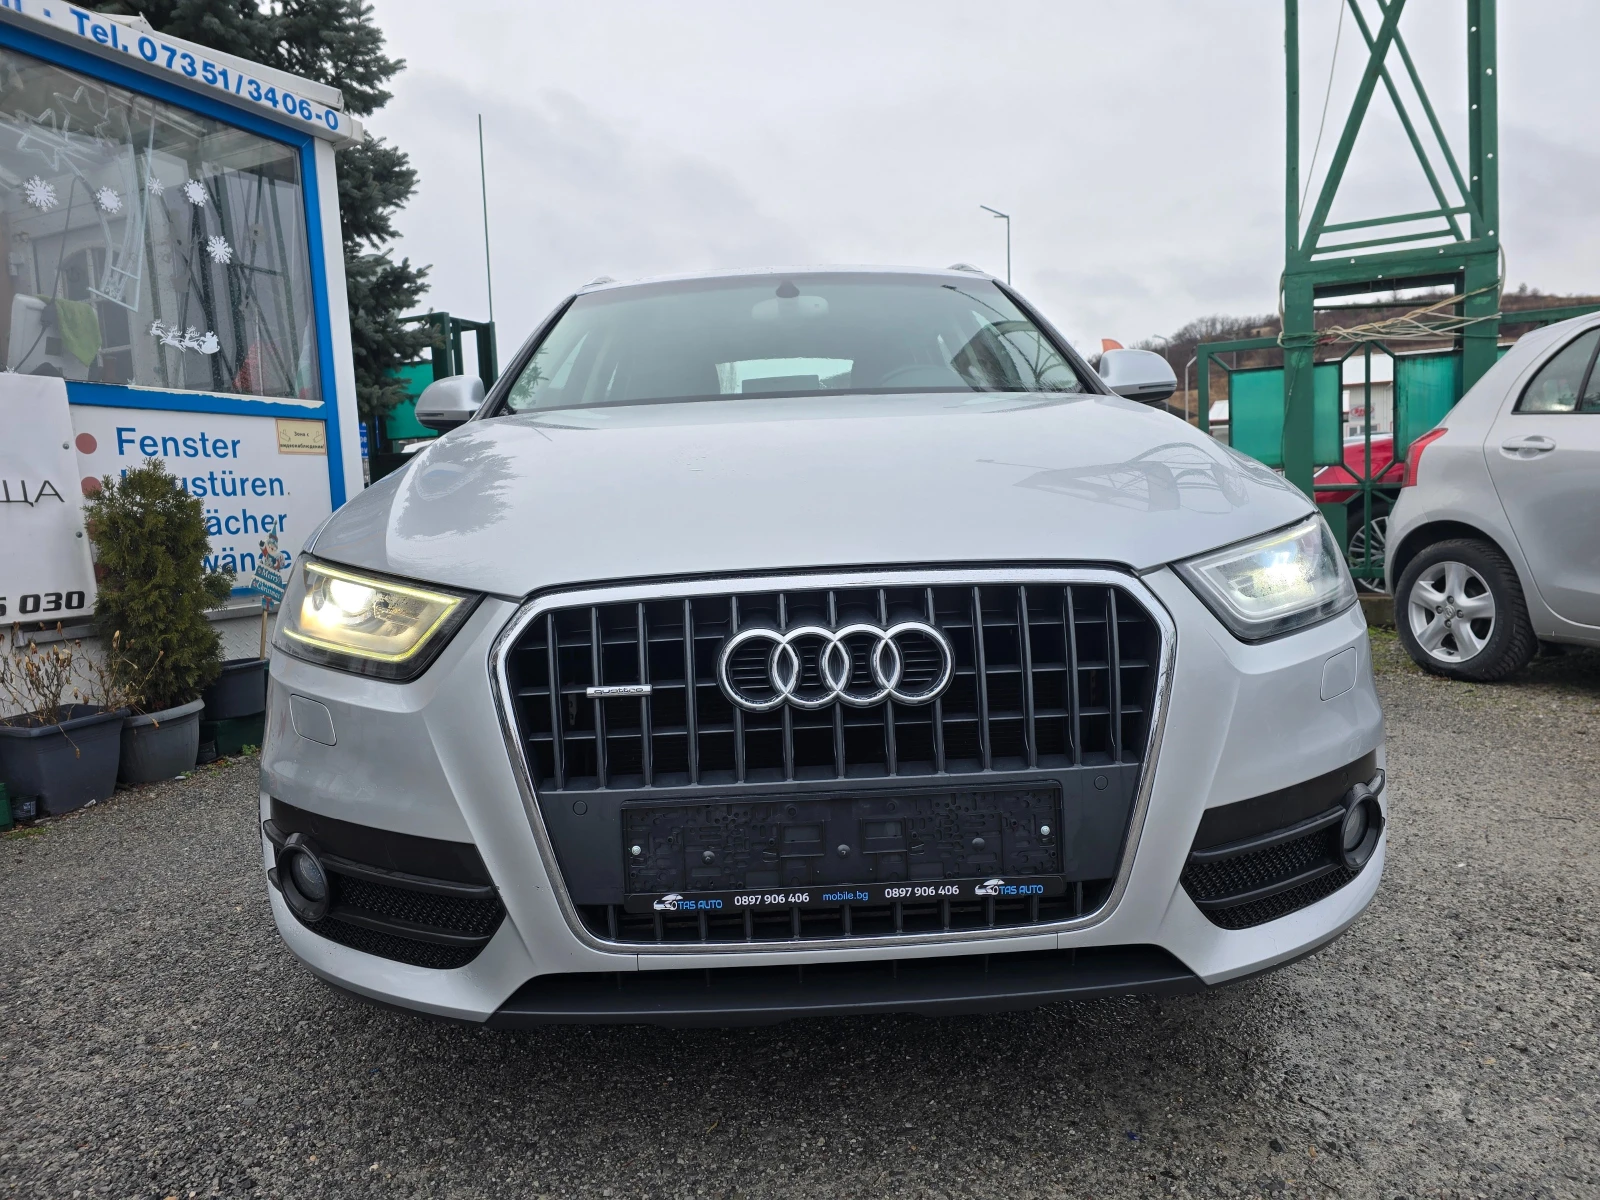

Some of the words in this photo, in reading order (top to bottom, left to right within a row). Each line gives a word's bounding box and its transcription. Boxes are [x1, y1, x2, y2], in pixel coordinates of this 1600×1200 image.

[69, 7, 129, 53] Tel.
[138, 36, 339, 131] 07351/3406-0
[116, 427, 241, 458] Fenster
[120, 469, 284, 497] ustüren
[205, 508, 287, 536] ächer
[261, 568, 280, 583] Merry
[19, 590, 85, 614] 030
[594, 687, 644, 695] quattro
[677, 899, 696, 910] TAS
[697, 899, 723, 910] AUTO
[734, 895, 761, 906] 0897
[764, 893, 786, 904] 906
[788, 892, 810, 903] 406
[822, 889, 869, 902] mobile.bg
[884, 887, 912, 898] 0897
[914, 886, 936, 897] 906
[938, 885, 960, 895] 406
[999, 885, 1018, 895] TAS
[1019, 884, 1044, 894] AUTO
